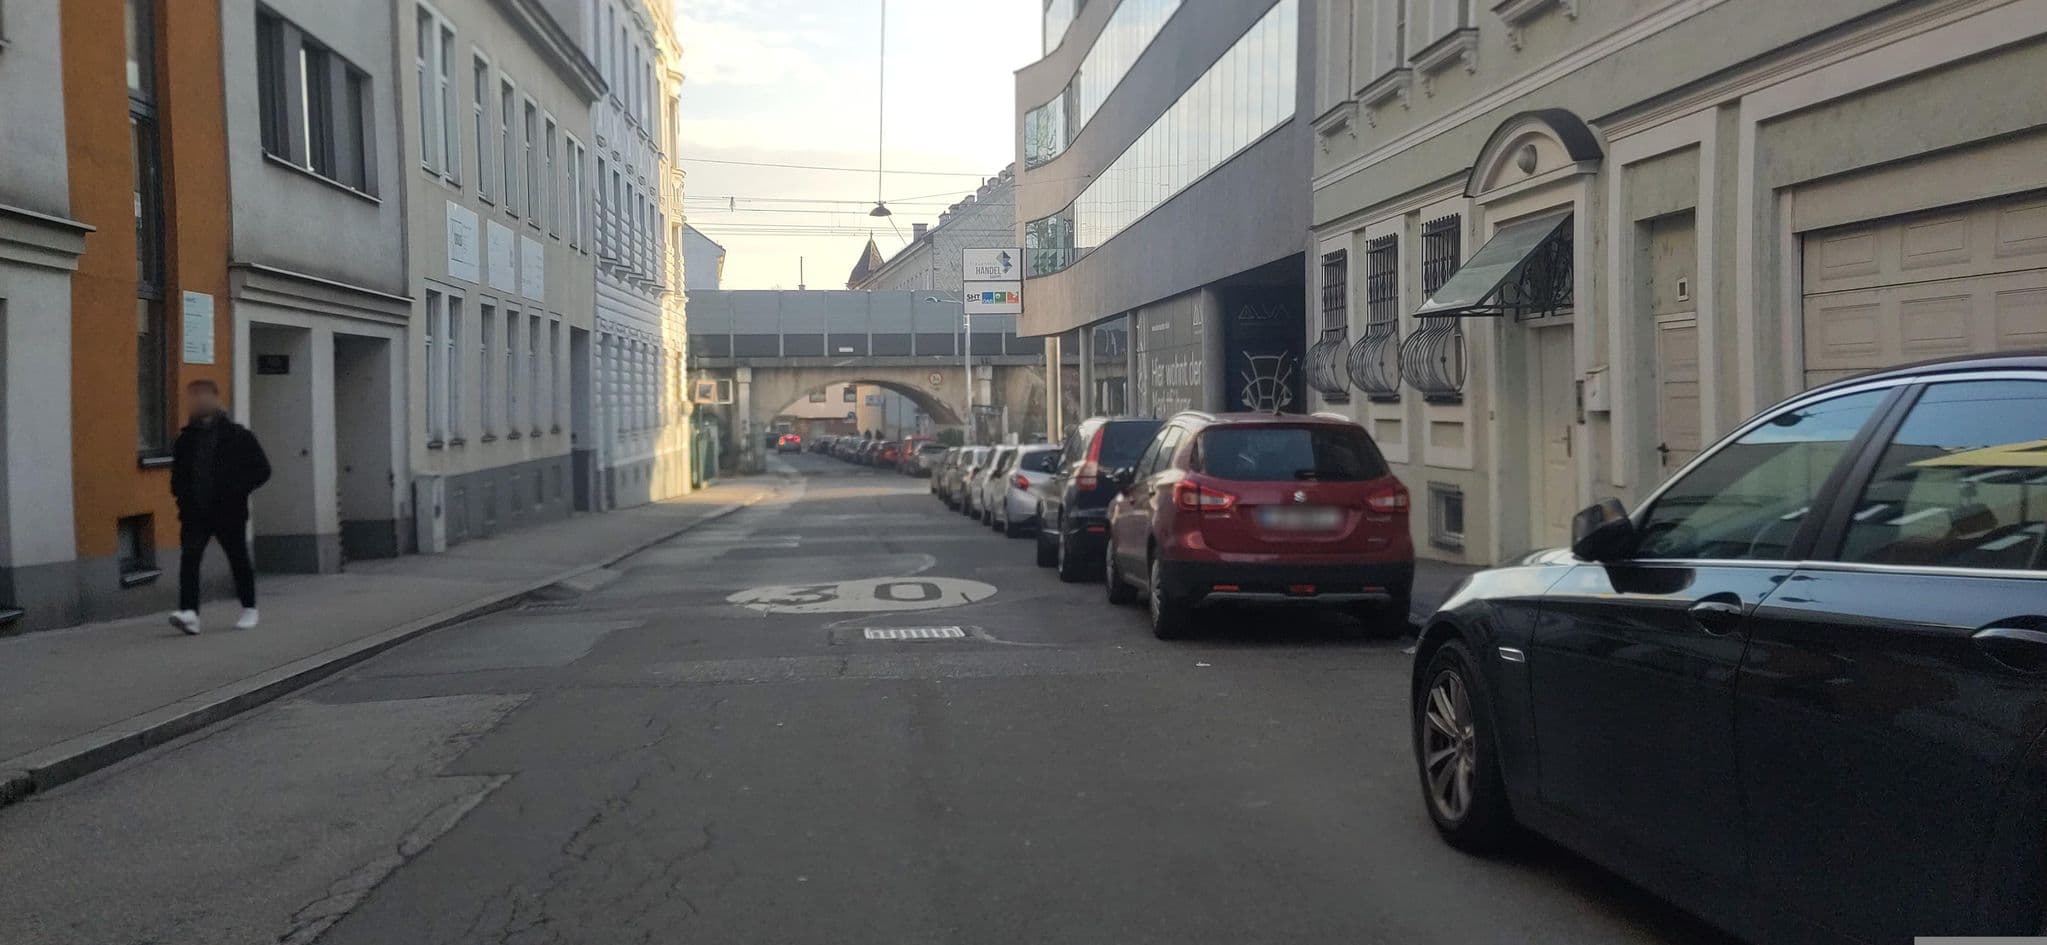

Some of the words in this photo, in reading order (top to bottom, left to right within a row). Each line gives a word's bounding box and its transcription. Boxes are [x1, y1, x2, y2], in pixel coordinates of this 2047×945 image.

[975, 266, 1001, 275] HANDEL
[1165, 352, 1188, 387] wohnt
[1189, 351, 1202, 386] der
